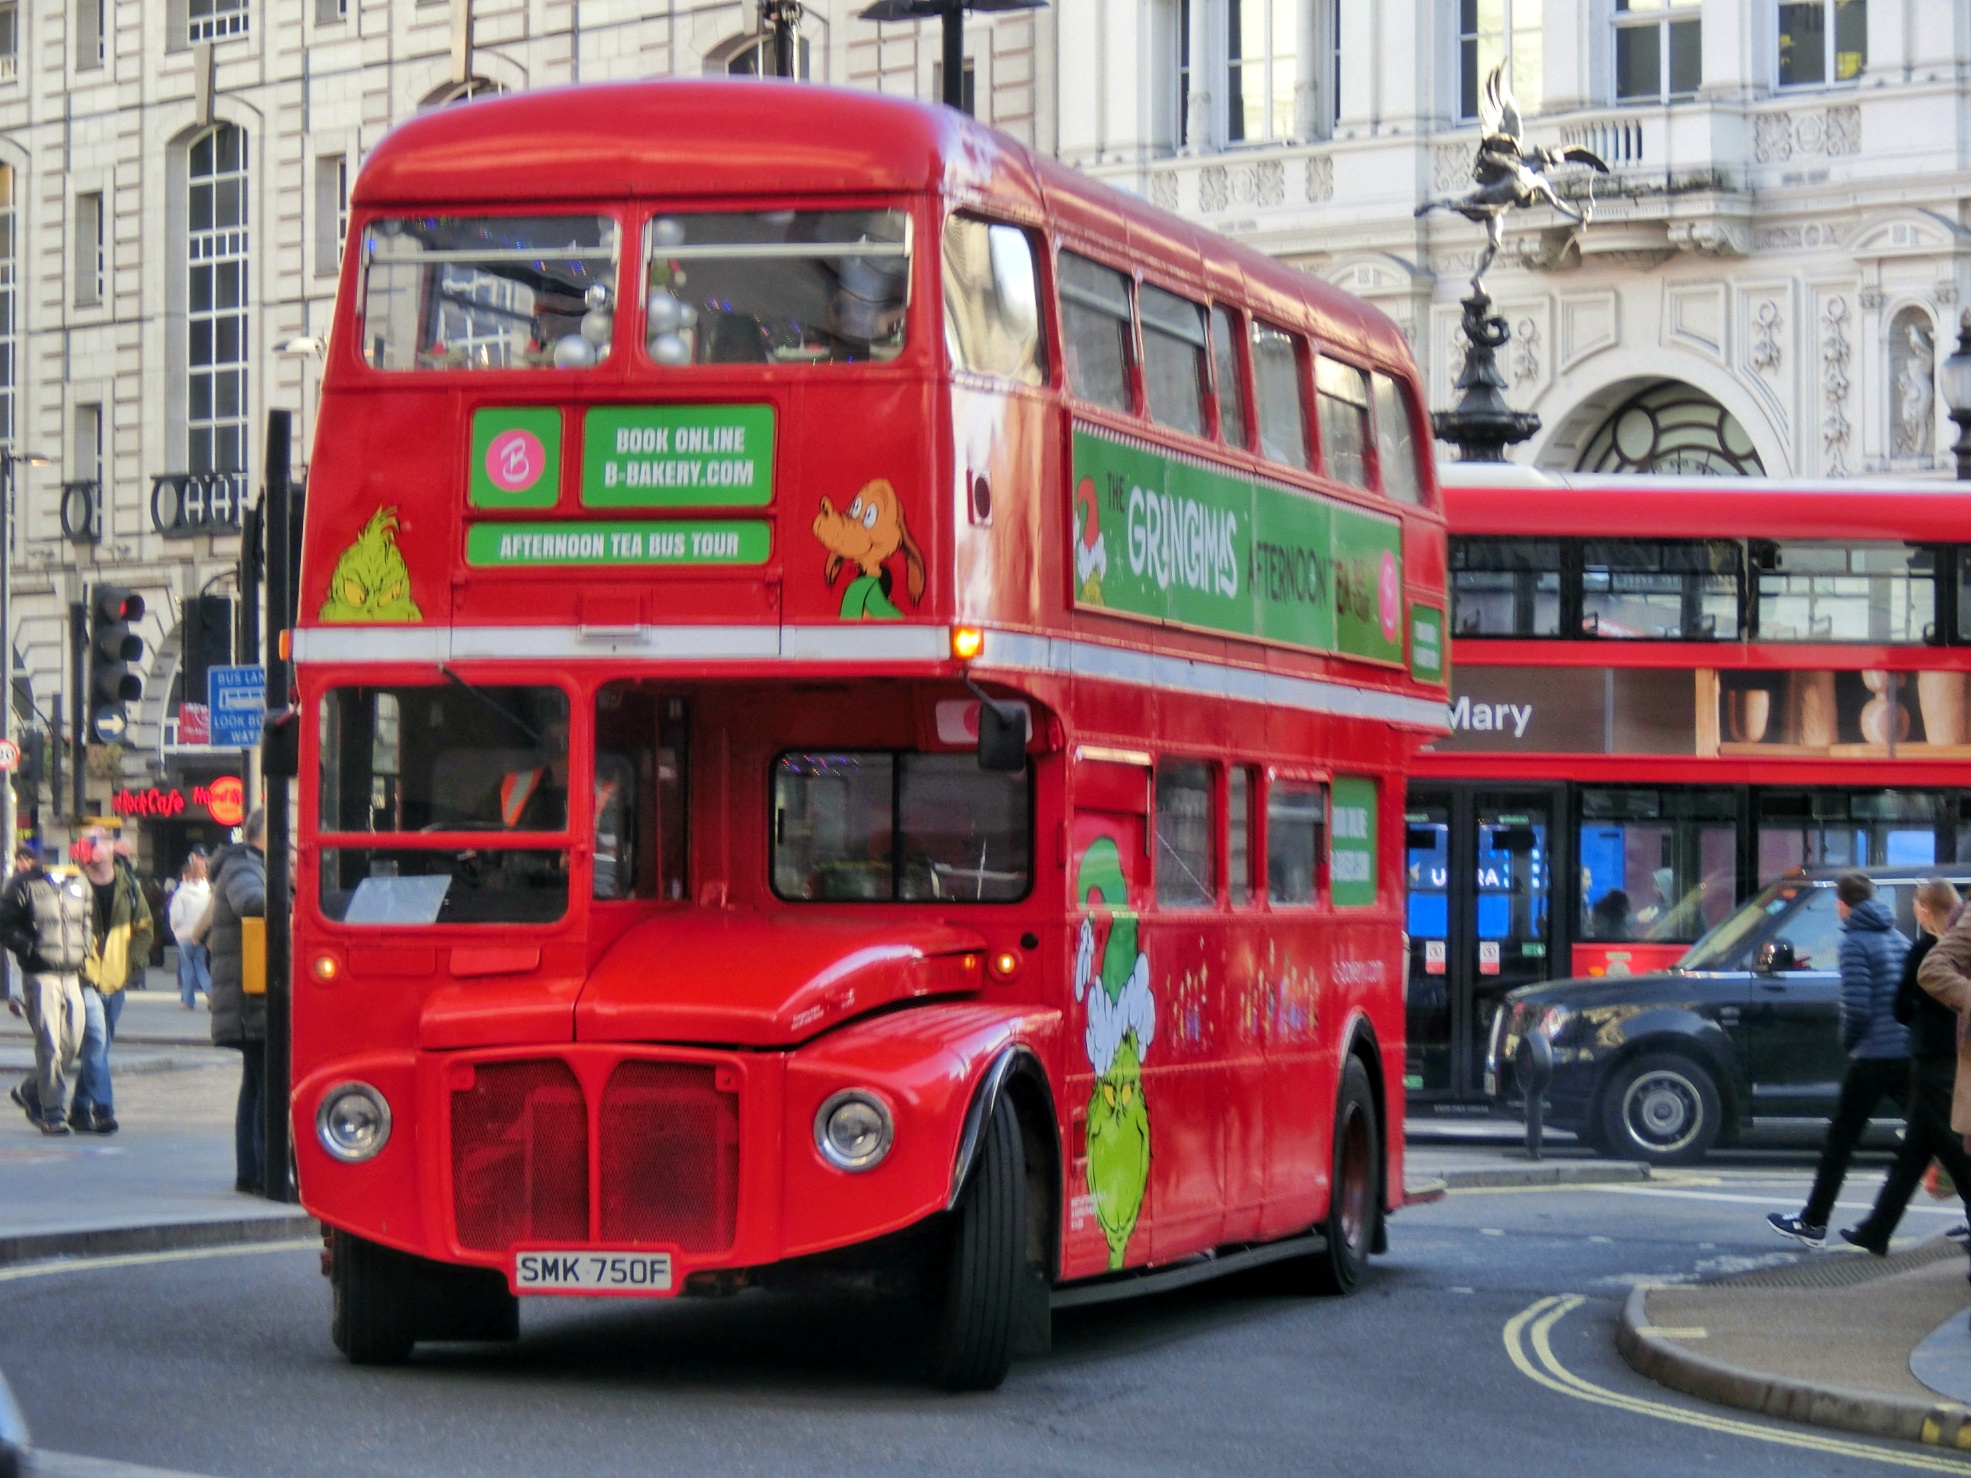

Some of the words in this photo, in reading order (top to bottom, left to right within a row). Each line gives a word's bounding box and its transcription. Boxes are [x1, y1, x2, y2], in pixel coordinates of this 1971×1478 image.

[616, 428, 668, 454] BOOK
[675, 427, 744, 453] ONLINE
[604, 460, 753, 488] B-BAKERY.COM
[1108, 472, 1124, 513] THE
[500, 533, 604, 559] AFTERNOON
[611, 533, 642, 558] TEA
[649, 532, 684, 557] BUS
[692, 531, 739, 557] TOUR
[217, 670, 241, 686] BUS
[244, 670, 265, 685] LAN
[213, 714, 245, 729] LOOK
[1449, 696, 1532, 738] Mary
[521, 1257, 580, 1282] SMK
[590, 1258, 667, 1283] 750F
